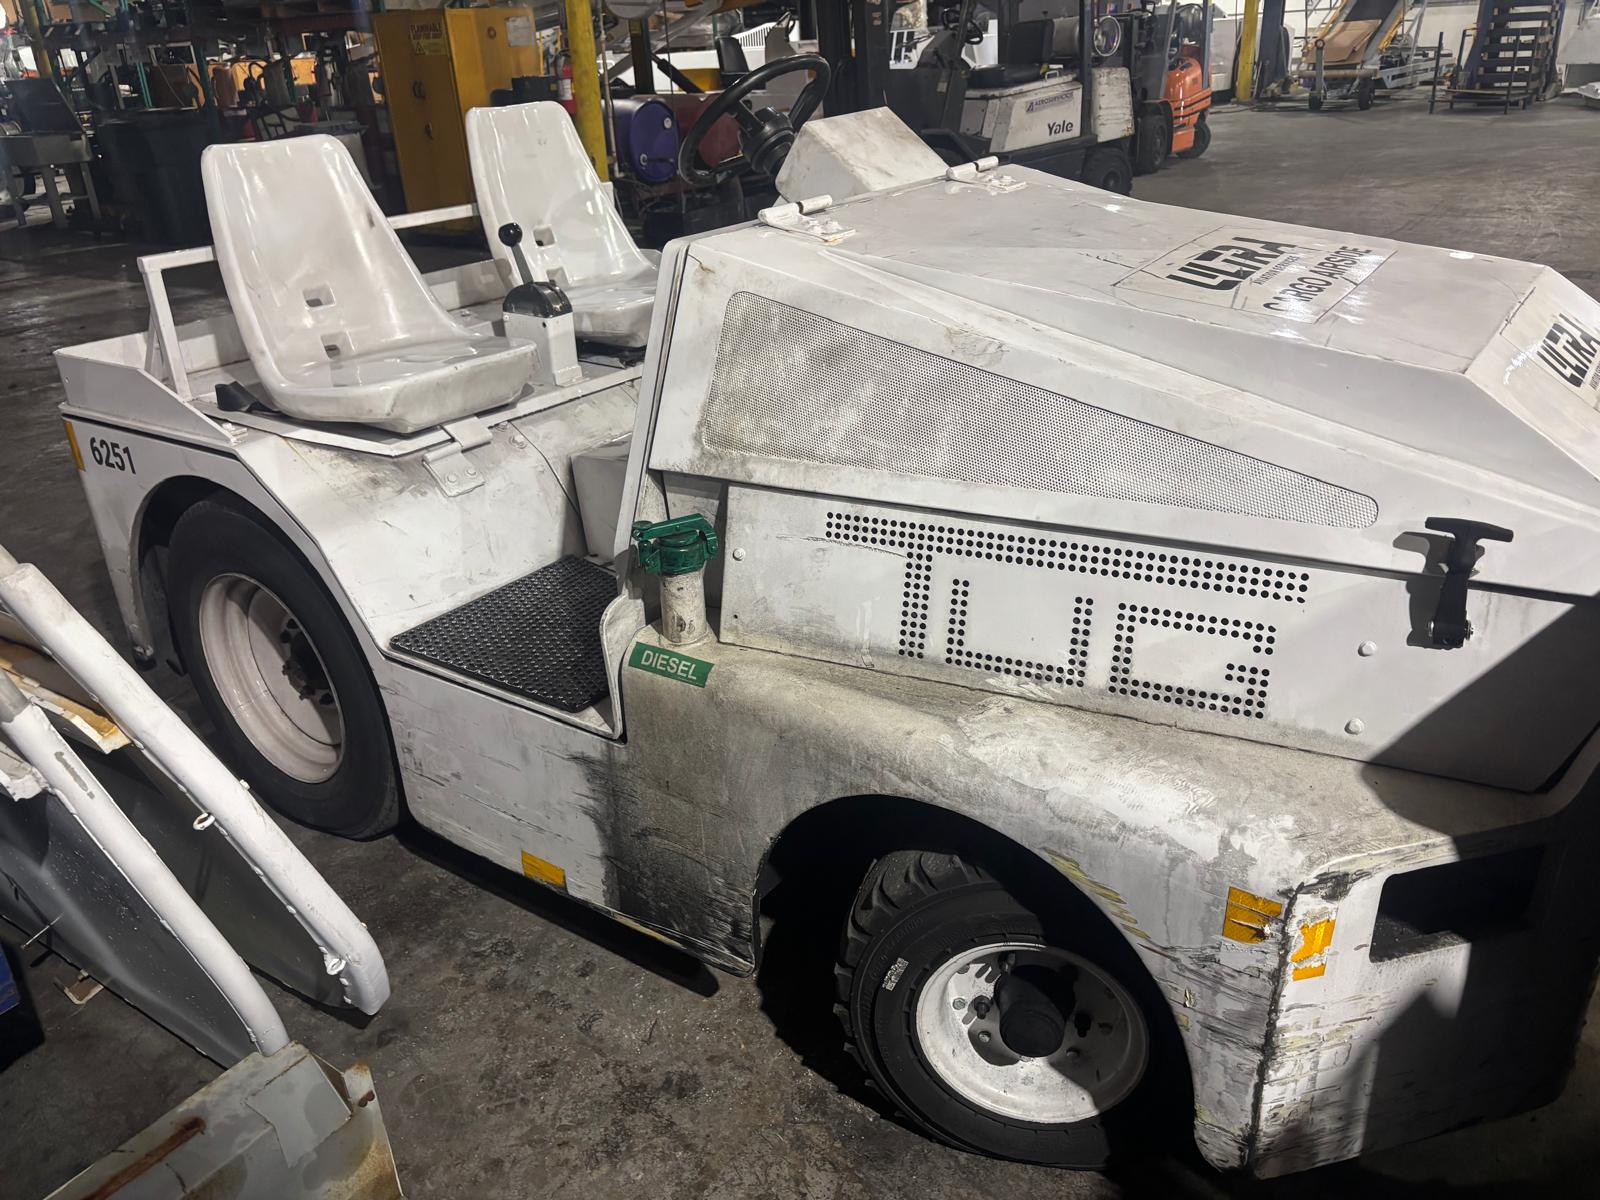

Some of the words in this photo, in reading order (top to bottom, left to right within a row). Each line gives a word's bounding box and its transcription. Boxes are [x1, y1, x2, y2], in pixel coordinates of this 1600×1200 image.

[1047, 120, 1074, 137] Yale
[1165, 236, 1297, 291] ULTRA
[1309, 246, 1373, 280] AIRSIDE
[89, 436, 137, 475] 6251
[826, 511, 1310, 719] TUG
[640, 650, 698, 681] DIESEL
